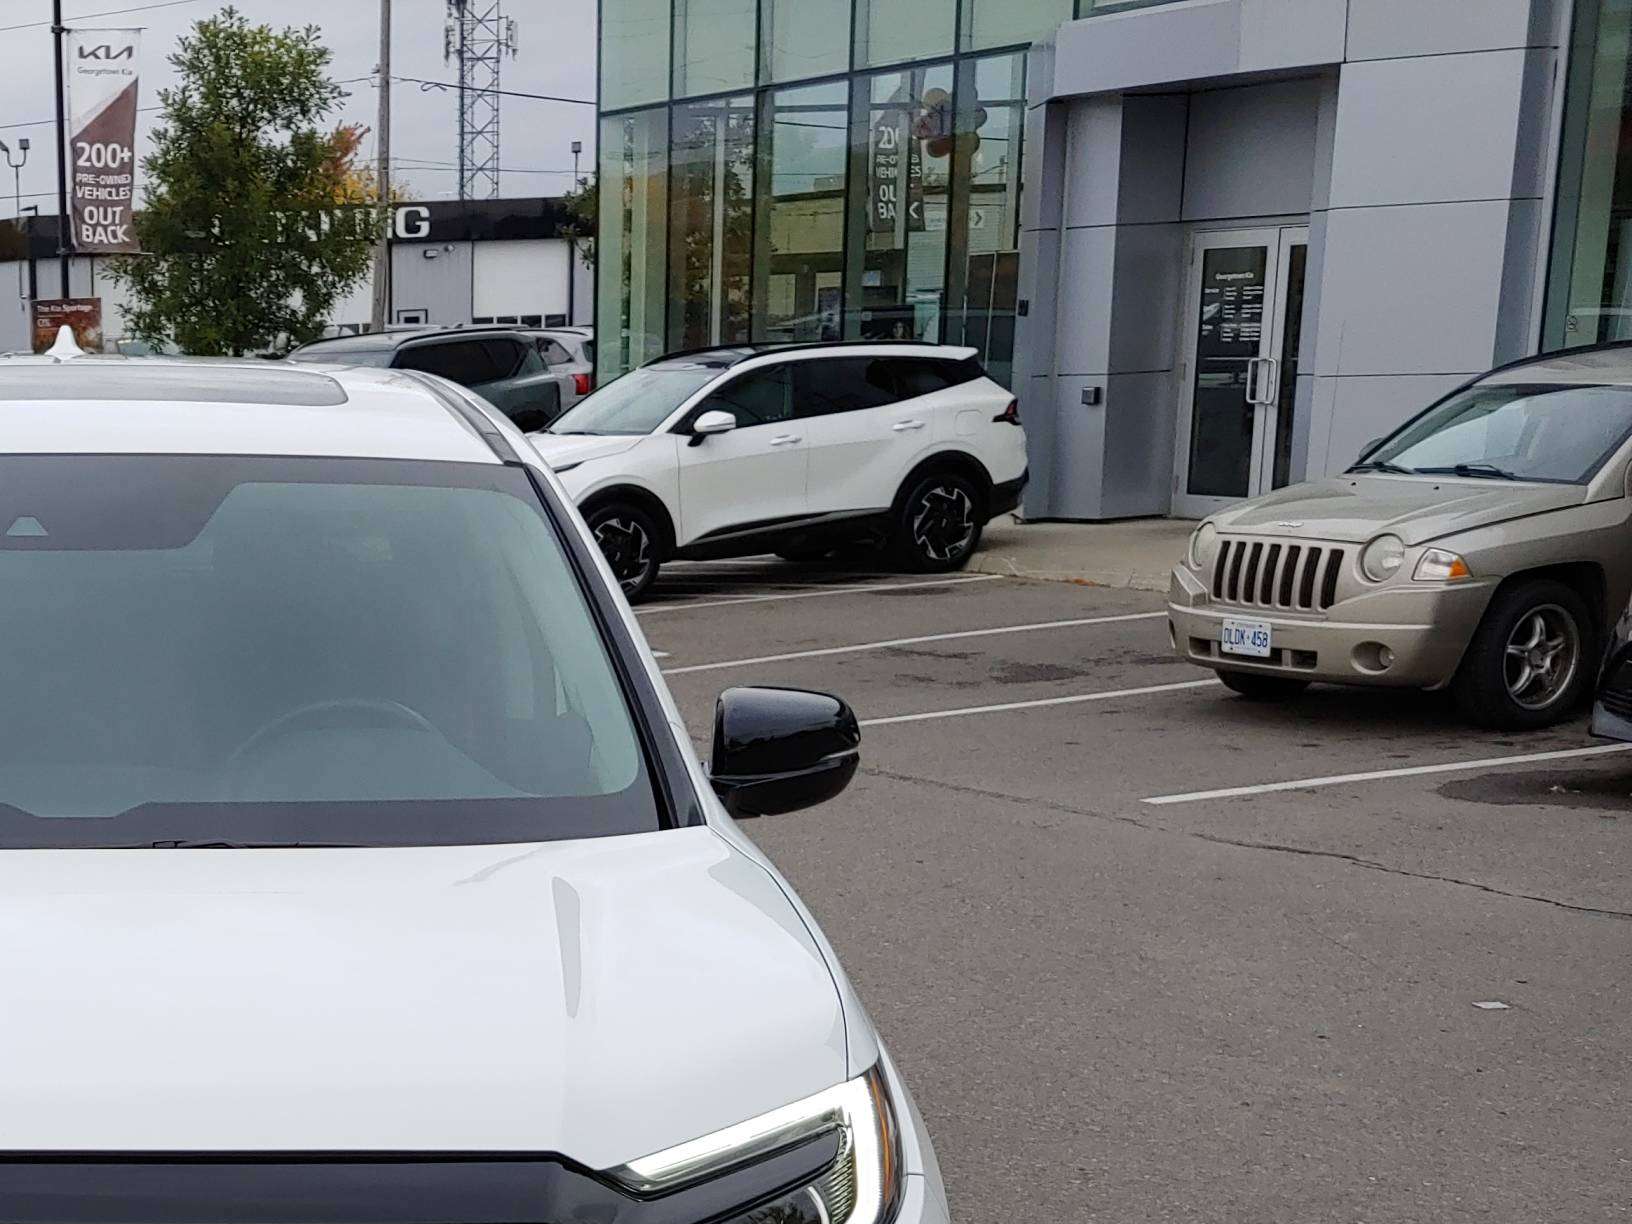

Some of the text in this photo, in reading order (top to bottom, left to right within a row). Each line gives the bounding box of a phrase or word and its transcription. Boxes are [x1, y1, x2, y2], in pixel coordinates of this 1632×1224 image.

[76, 141, 132, 168] 200+
[76, 173, 132, 184] PRE-OWNED
[76, 186, 131, 200] VEHICLES
[84, 206, 124, 225] OUT
[81, 224, 130, 244] BACK
